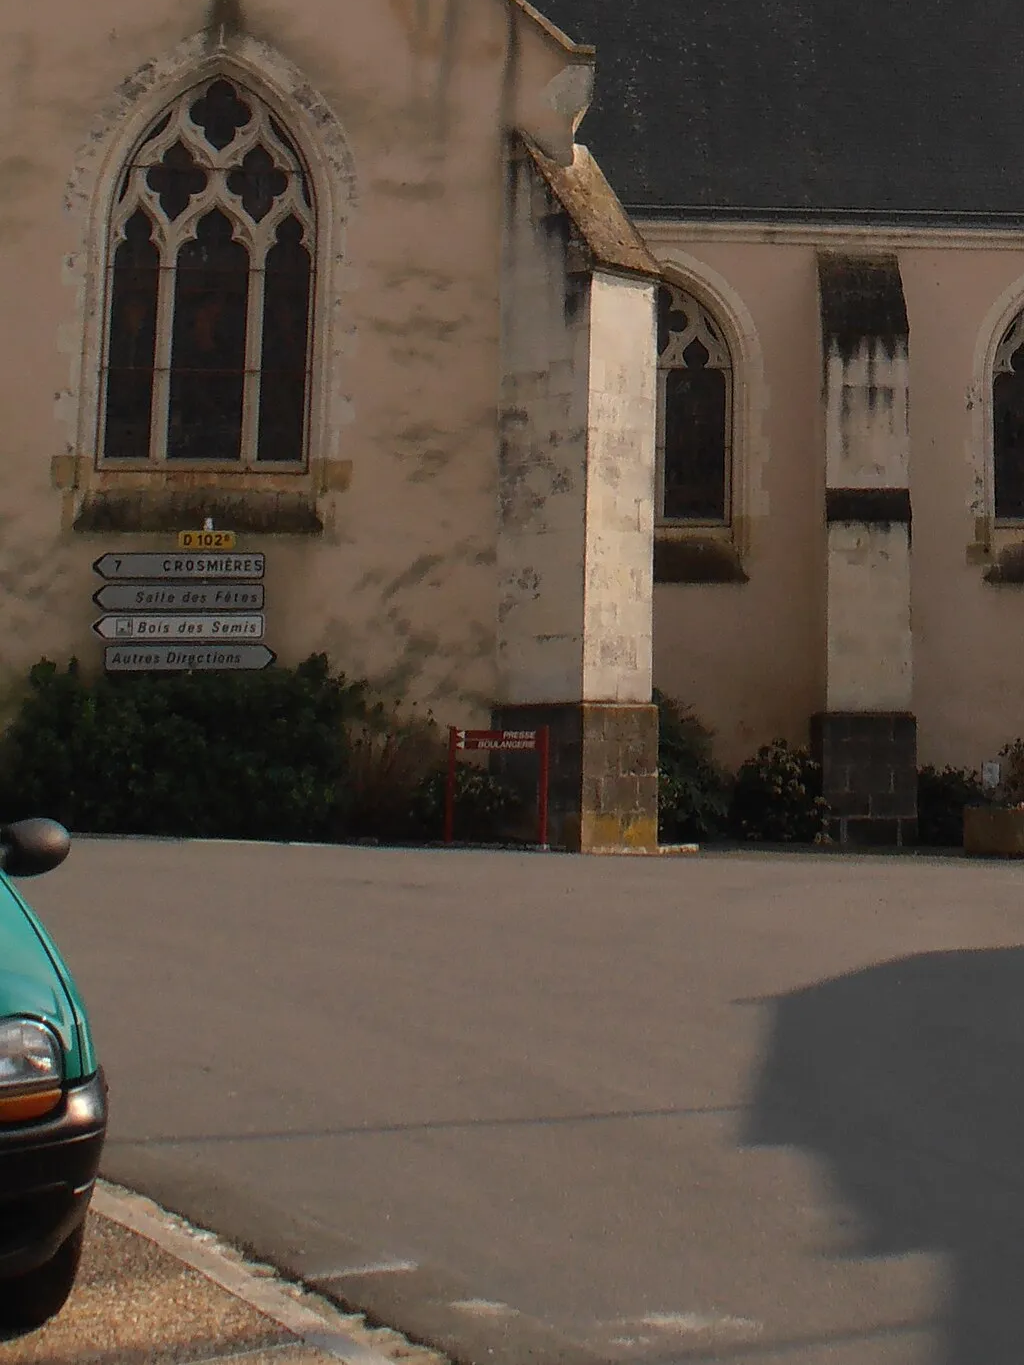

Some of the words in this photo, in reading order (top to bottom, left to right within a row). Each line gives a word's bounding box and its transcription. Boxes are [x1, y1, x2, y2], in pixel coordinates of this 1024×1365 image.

[183, 534, 192, 546] D
[115, 560, 122, 571] 7
[136, 591, 175, 603] Salle
[182, 591, 207, 603] des
[215, 590, 258, 603] Fêtes
[137, 621, 170, 633] Bois
[178, 621, 203, 633] des
[212, 620, 256, 633] Semis
[111, 652, 161, 664] Autres
[166, 651, 241, 664] Directions
[503, 731, 535, 739] PRESSE
[478, 740, 535, 748] BOULANGERIE
